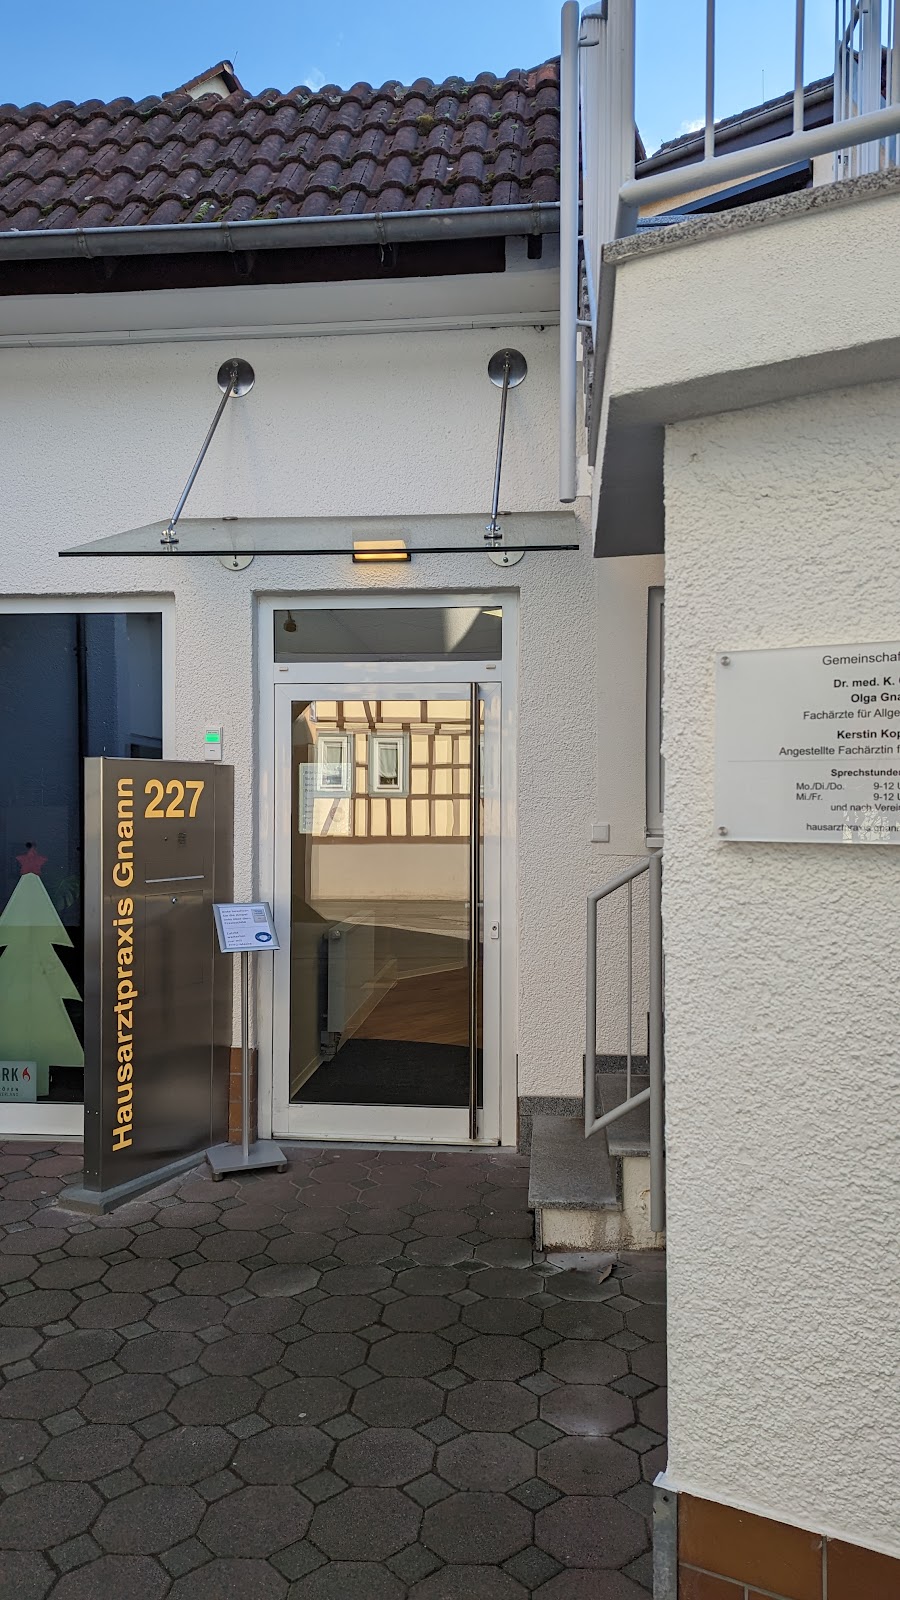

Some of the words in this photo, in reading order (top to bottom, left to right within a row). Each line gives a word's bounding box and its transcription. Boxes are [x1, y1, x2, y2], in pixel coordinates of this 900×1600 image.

[833, 678, 849, 688] Dr.
[852, 676, 880, 687] med.
[883, 676, 895, 686] K.
[850, 693, 877, 705] Olga
[803, 709, 855, 720] Fachärzte
[857, 708, 872, 719] für
[837, 729, 877, 739] Kerstin
[779, 745, 836, 758] Angestellte
[838, 744, 894, 755] Fachärztin
[830, 767, 900, 779] Sprechstunde
[796, 781, 845, 791] Mo./Di./Do.
[873, 781, 895, 791] 9-12
[144, 778, 205, 819] 227
[796, 792, 823, 801] Mi./Fr.
[873, 792, 895, 801] 9-12
[830, 803, 848, 812] und
[850, 803, 872, 812] nach
[112, 777, 134, 888] Gnann
[112, 896, 139, 1152] Hausarztpraxis
